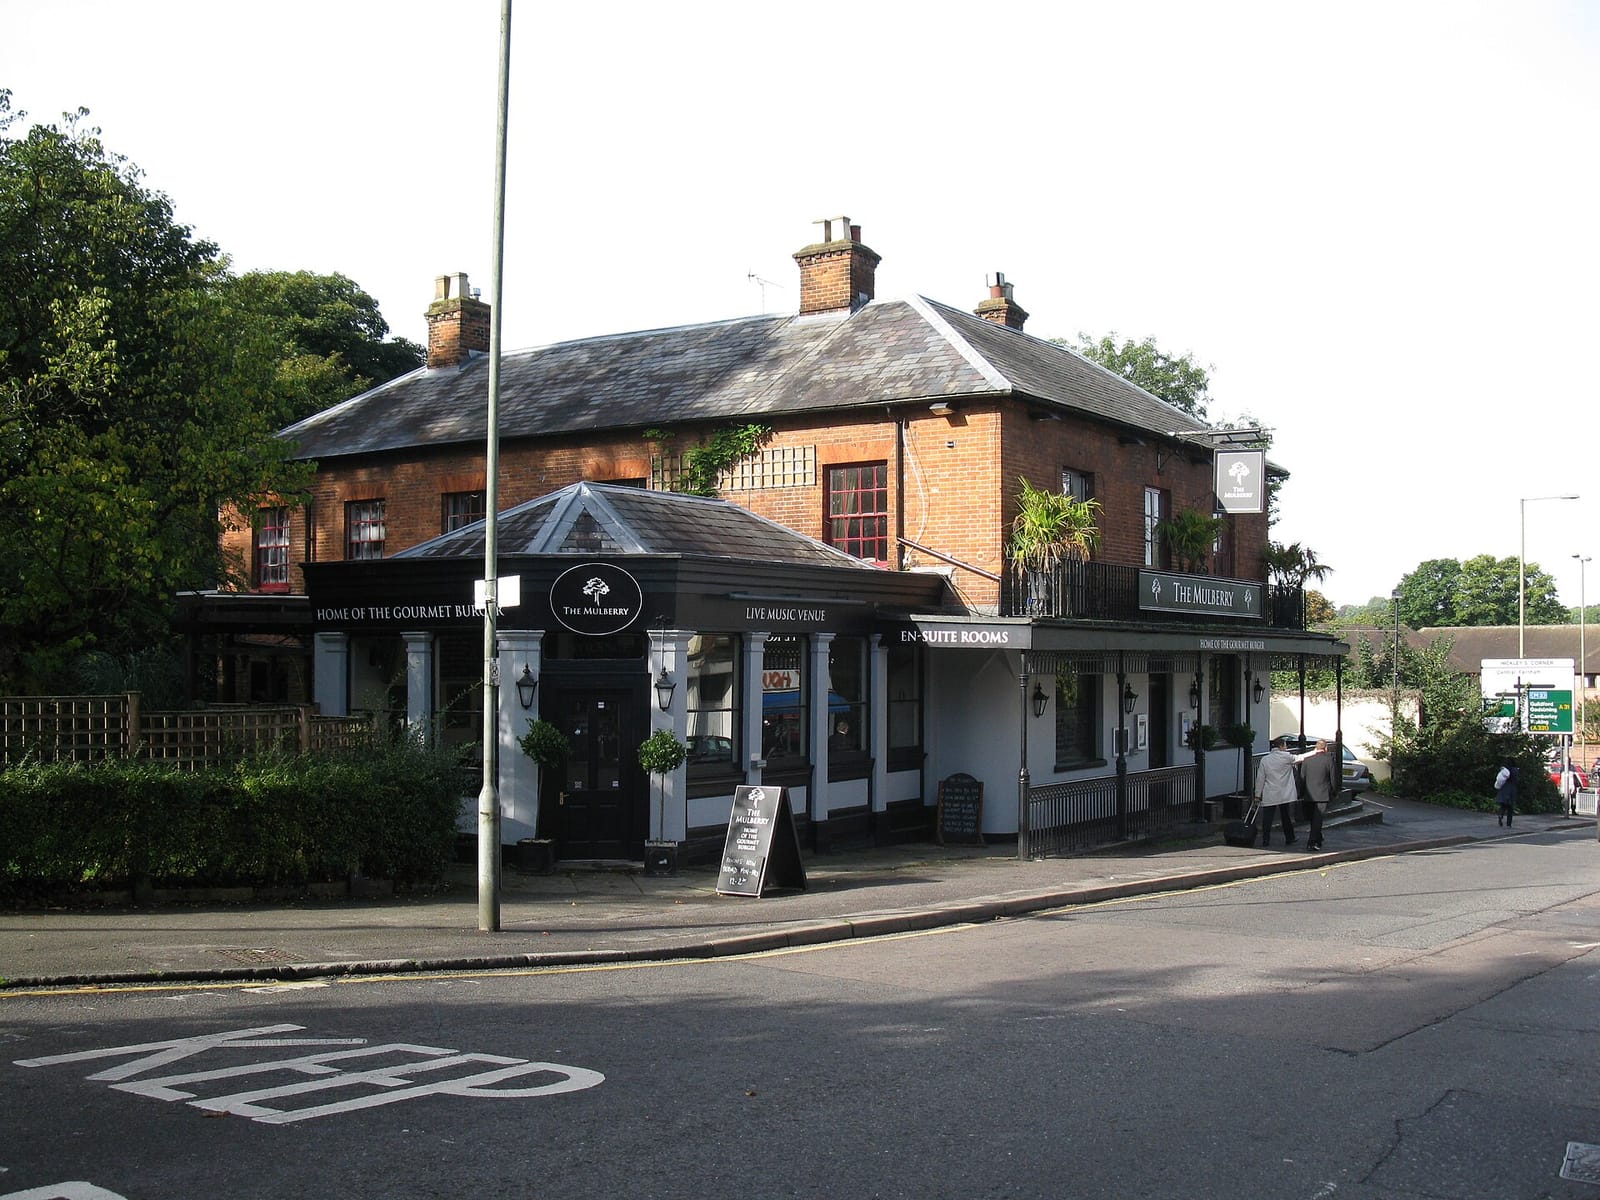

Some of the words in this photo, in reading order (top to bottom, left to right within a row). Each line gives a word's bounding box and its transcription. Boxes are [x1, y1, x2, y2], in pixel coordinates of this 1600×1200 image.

[1173, 582, 1192, 604] THE
[1193, 584, 1234, 607] MULBERRY
[317, 608, 350, 621] HOME
[351, 608, 366, 620] OF
[369, 606, 391, 620] THE
[392, 605, 453, 620] GOURMET
[454, 604, 505, 618] BURR
[562, 606, 582, 616] THE
[583, 606, 629, 616] MULBERRY
[746, 607, 765, 620] LIVE
[767, 608, 796, 622] MUSIC
[797, 609, 826, 622] VENUE
[900, 630, 958, 643] EN-SUITE
[961, 630, 1009, 644] ROOMS
[746, 808, 760, 817] THE
[735, 816, 770, 825] MULBERRY
[12, 1024, 606, 1124] KEEP
